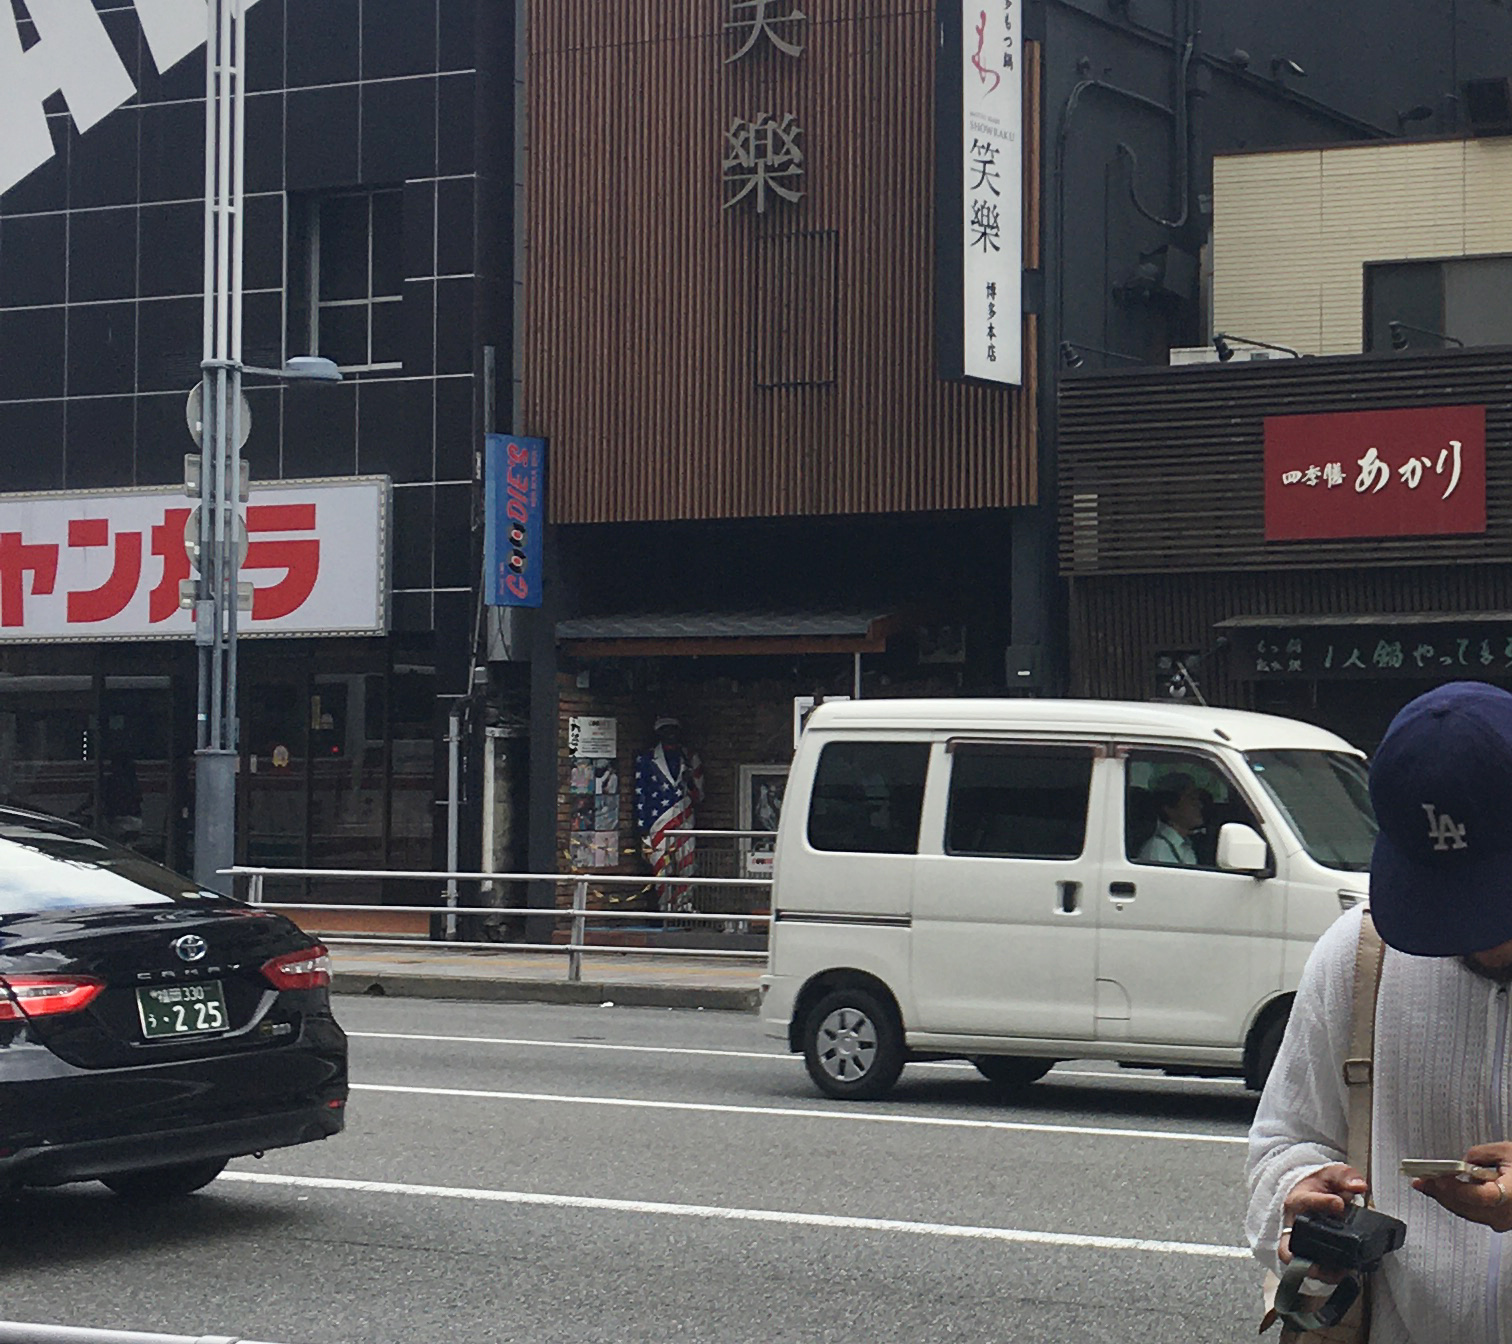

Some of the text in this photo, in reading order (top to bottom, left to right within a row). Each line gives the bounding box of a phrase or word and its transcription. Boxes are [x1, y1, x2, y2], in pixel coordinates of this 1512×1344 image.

[986, 282, 997, 362] 博多本店
[1355, 440, 1461, 499] あかり
[1421, 803, 1468, 851] LA
